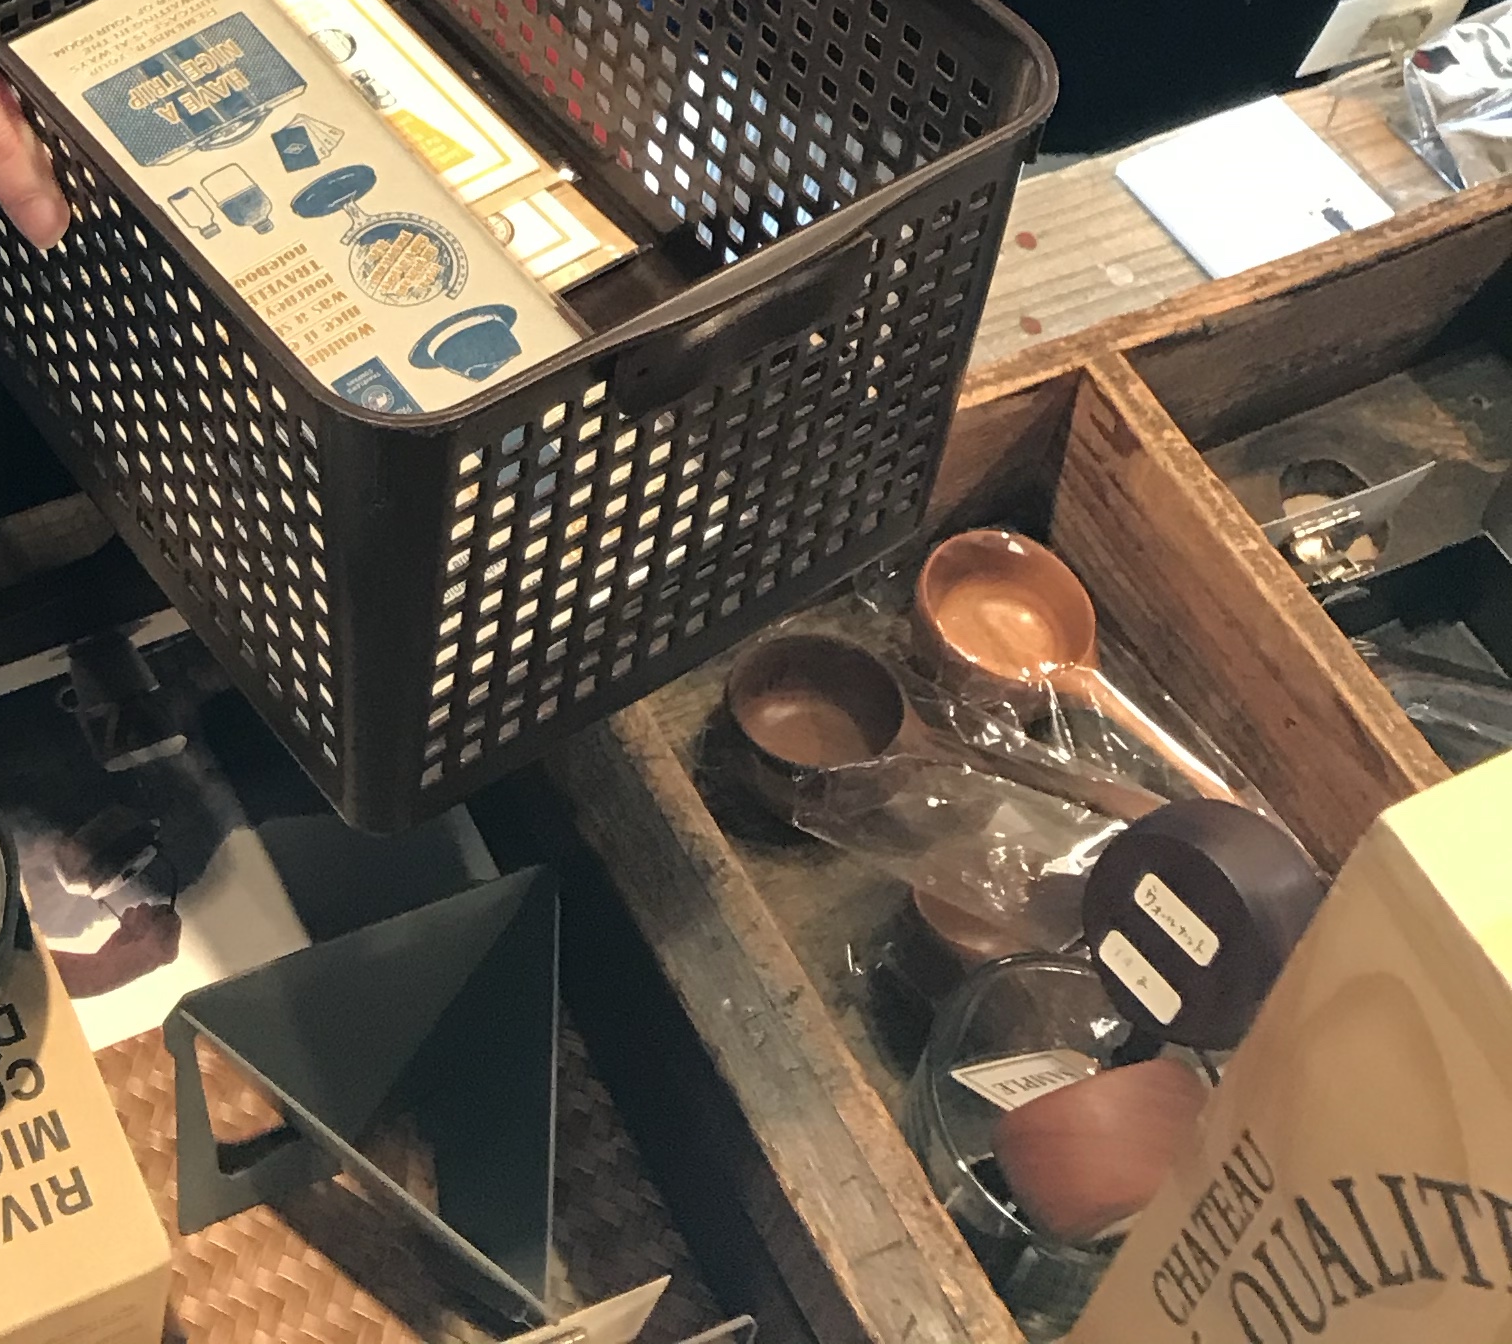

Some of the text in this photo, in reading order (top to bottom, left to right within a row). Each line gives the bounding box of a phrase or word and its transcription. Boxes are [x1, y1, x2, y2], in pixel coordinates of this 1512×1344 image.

[123, 35, 244, 113] NICE TRIP
[154, 65, 250, 129] HAVE A
[294, 311, 309, 326] a
[310, 288, 349, 317] was
[322, 303, 362, 334] nice
[1153, 1128, 1275, 1327] CHATEAU
